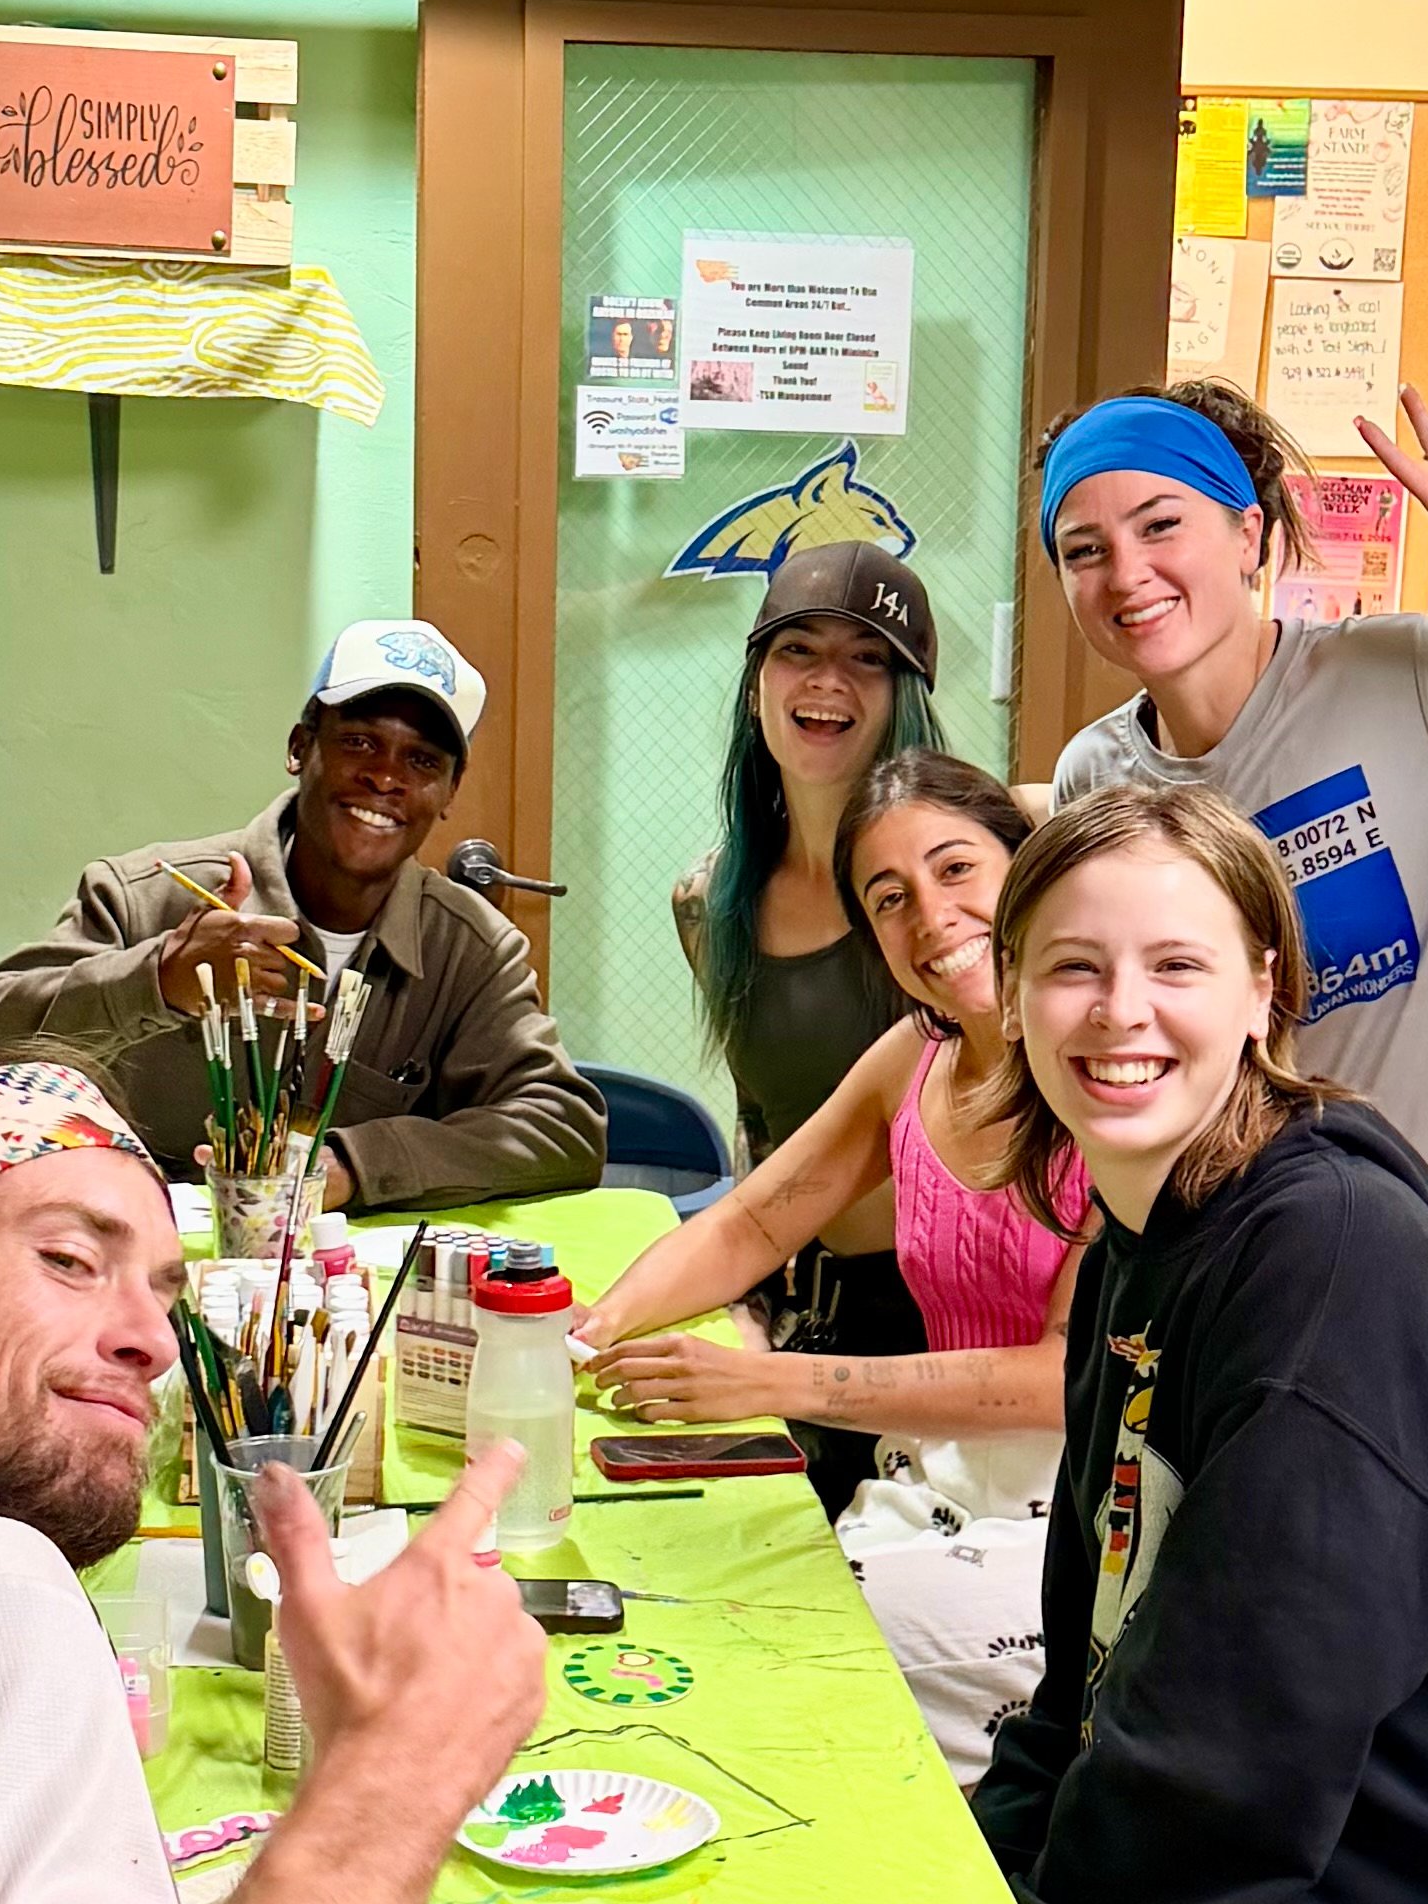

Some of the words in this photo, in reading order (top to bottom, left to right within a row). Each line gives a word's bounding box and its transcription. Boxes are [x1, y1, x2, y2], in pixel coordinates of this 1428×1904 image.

[80, 99, 162, 142] SIMPLY
[1320, 483, 1372, 494] OZEMAN
[1321, 494, 1369, 504] ASHION
[1277, 814, 1349, 858] 8.0072
[1356, 801, 1377, 824] N
[1365, 827, 1384, 849] E
[1350, 960, 1415, 996] WONDERS
